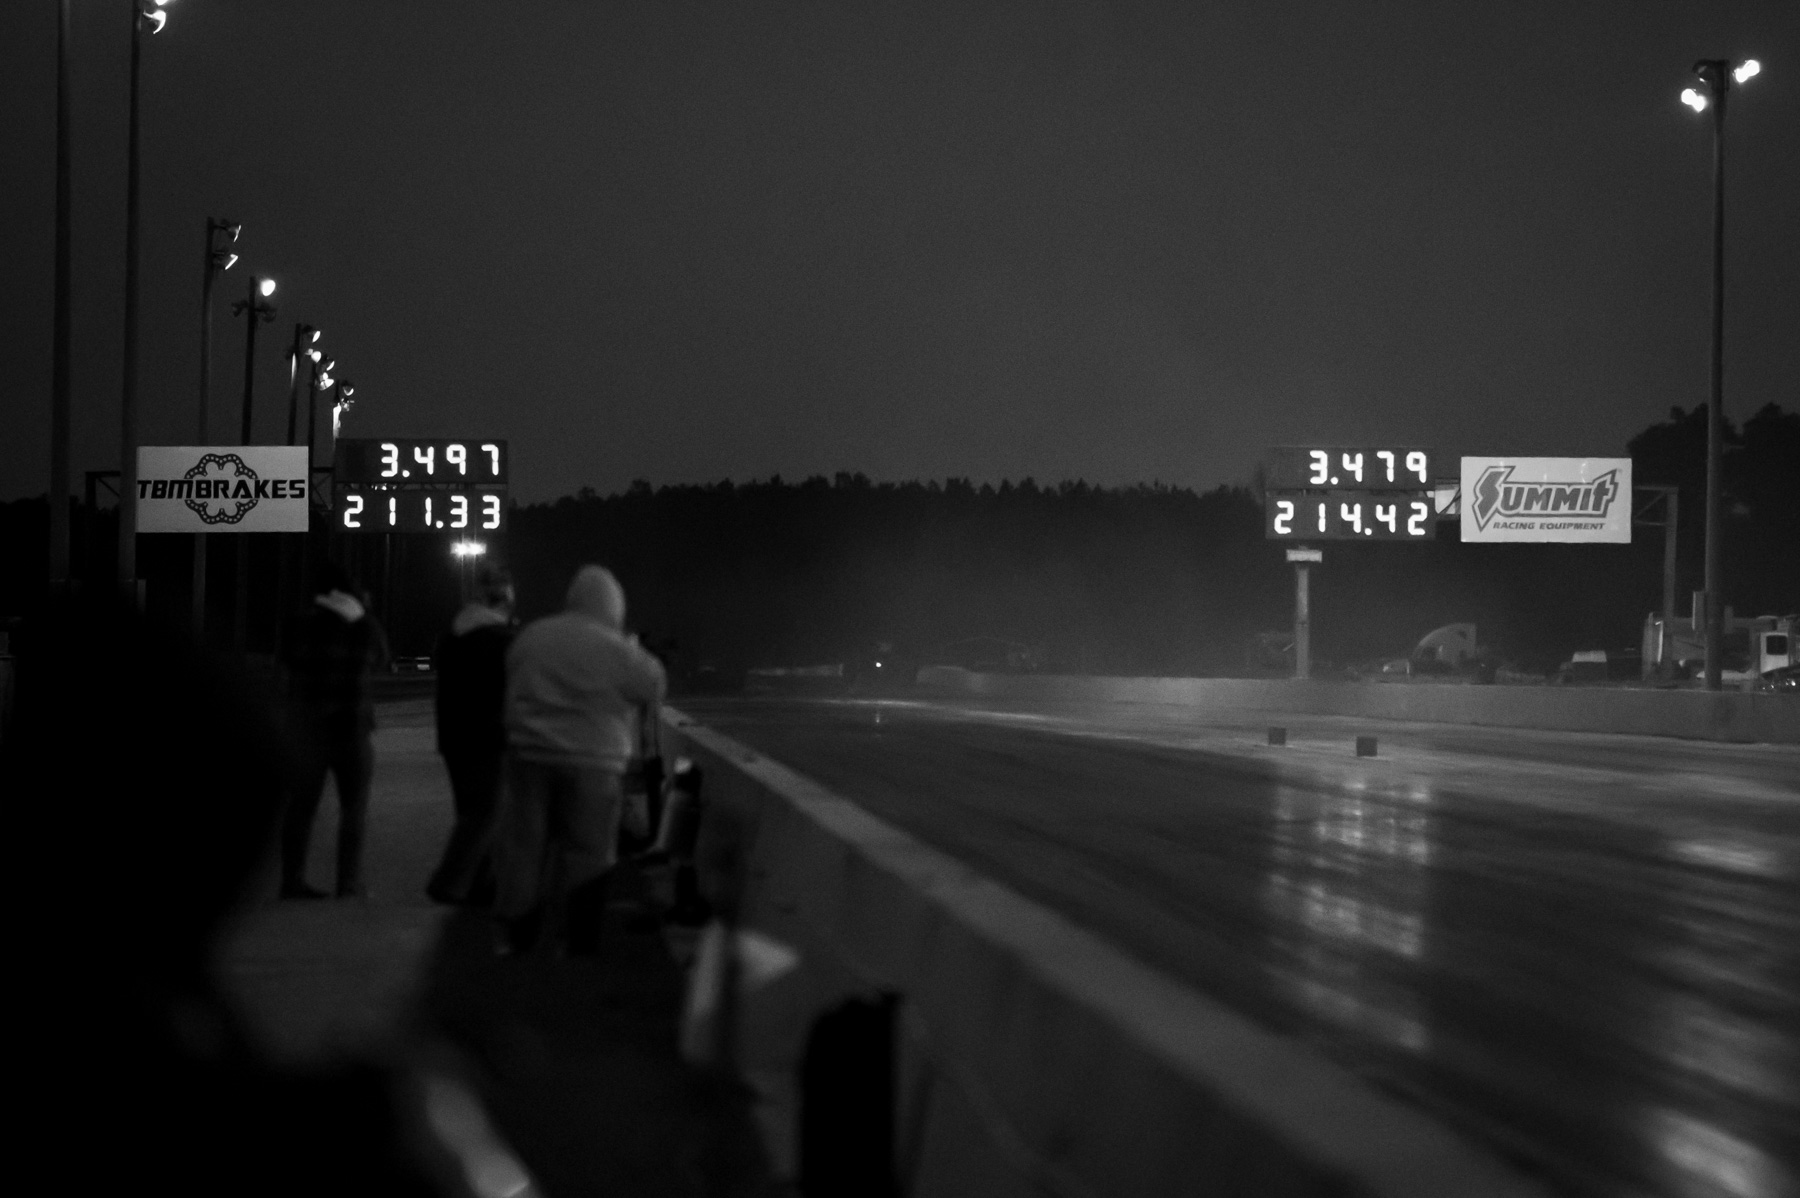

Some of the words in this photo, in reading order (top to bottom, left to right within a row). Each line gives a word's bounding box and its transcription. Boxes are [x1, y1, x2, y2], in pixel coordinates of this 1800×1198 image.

[381, 443, 499, 477] 3.497
[1309, 450, 1427, 484] 3.479
[344, 495, 500, 529] 211.33
[1274, 501, 1428, 535] 214.42
[1493, 521, 1536, 530] RACING
[1539, 522, 1606, 531] EQUIPMENT
